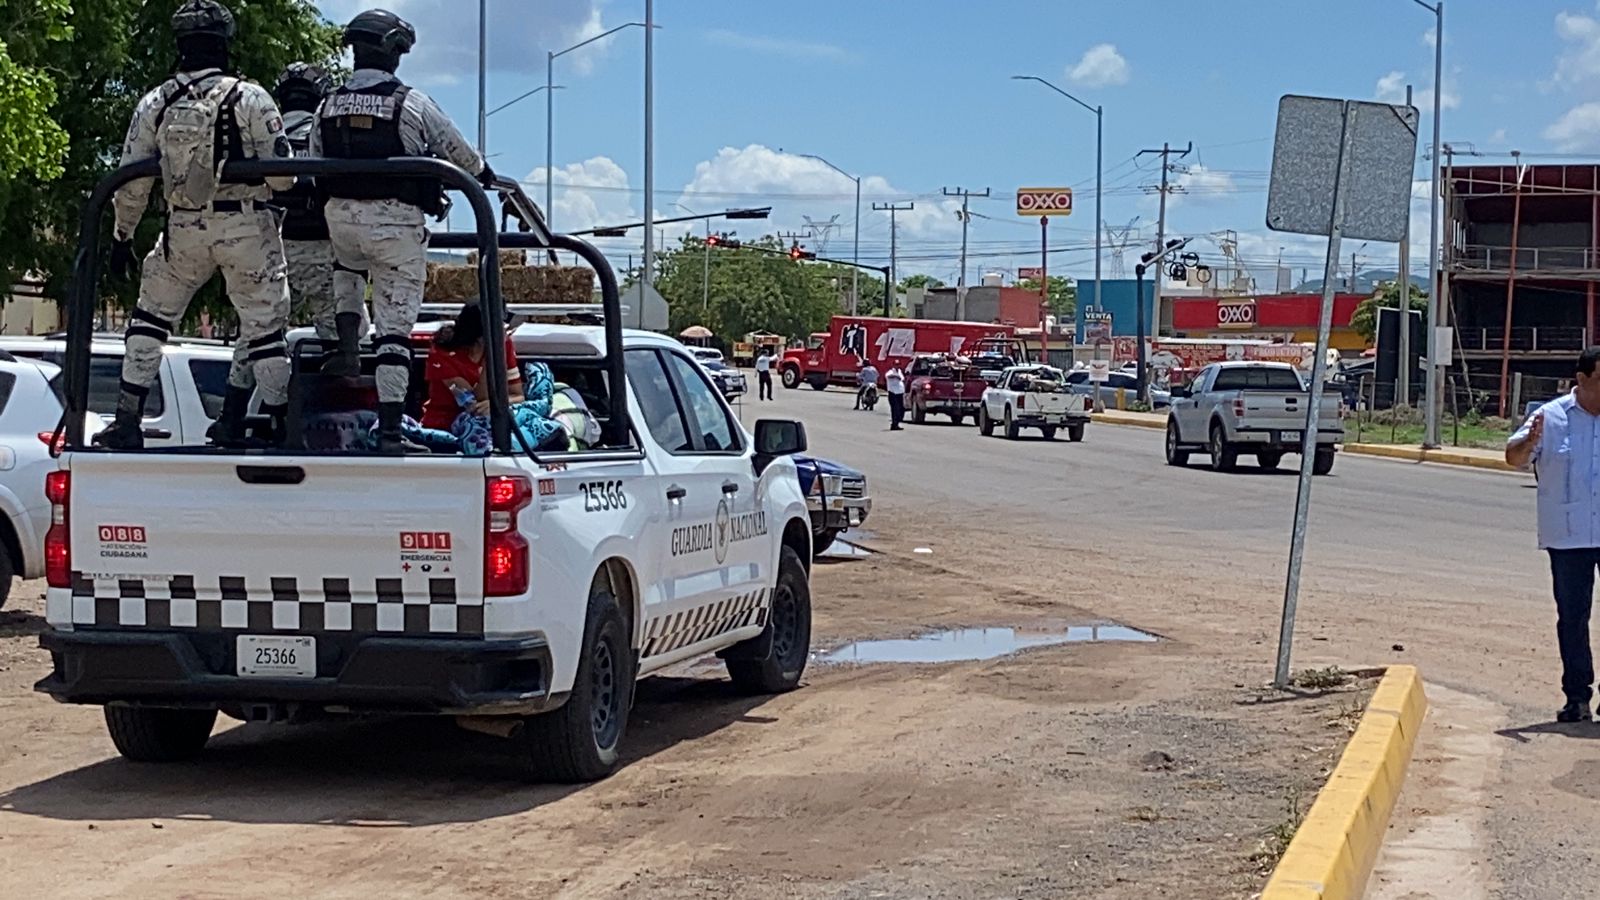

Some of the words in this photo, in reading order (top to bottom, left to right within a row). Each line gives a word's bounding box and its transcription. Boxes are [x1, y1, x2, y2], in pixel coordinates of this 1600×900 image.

[328, 105, 384, 117] NACIONAL
[1018, 194, 1070, 209] OXXO
[1218, 304, 1252, 323] OXXO
[578, 480, 627, 512] 25366
[100, 527, 143, 541] 088
[729, 510, 768, 543] NACIONAL
[403, 534, 446, 547] 911
[671, 522, 713, 557] GUARDIA
[100, 550, 148, 558] CIUDADANA
[255, 647, 297, 665] 25366
